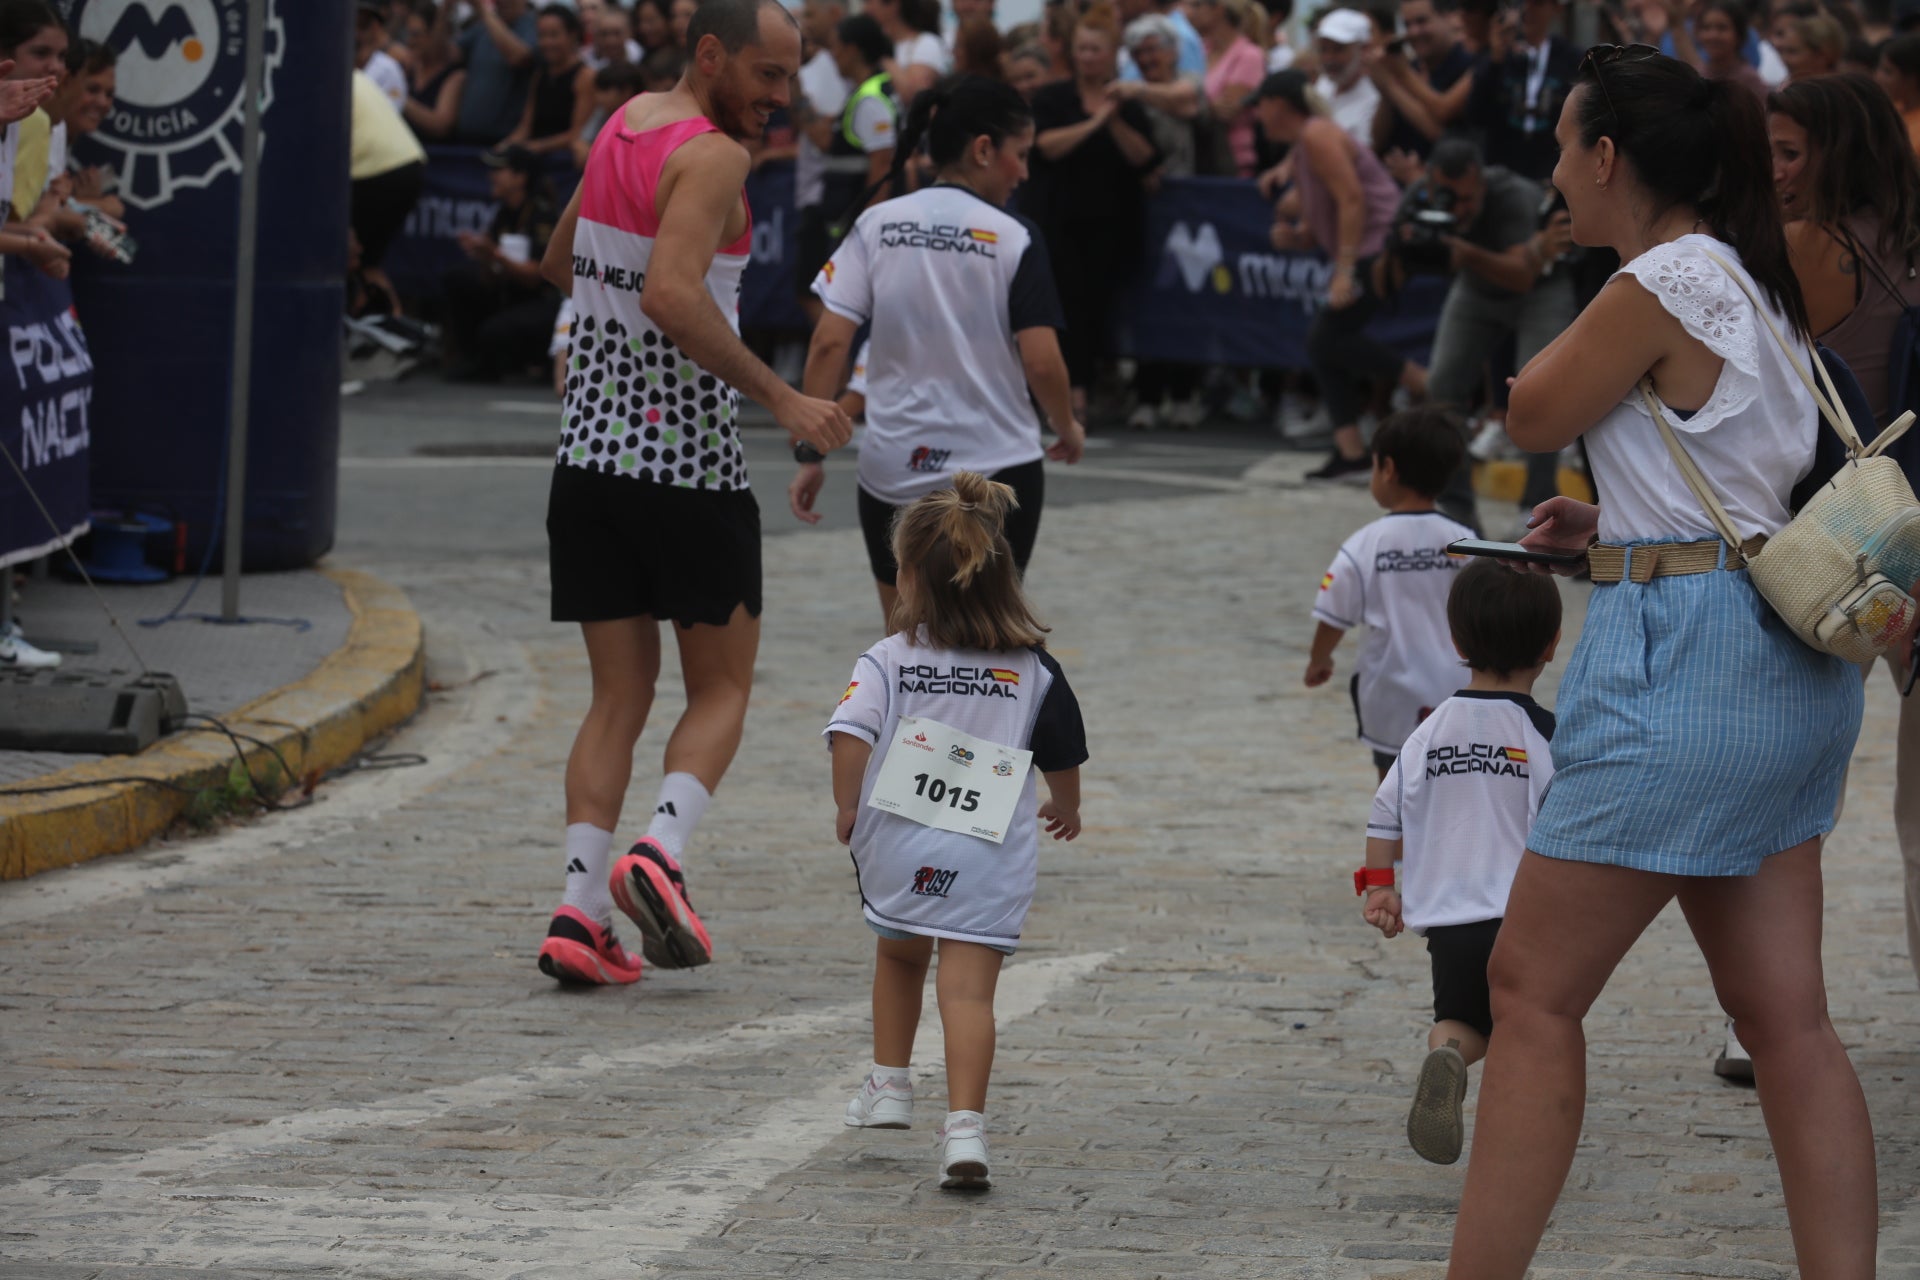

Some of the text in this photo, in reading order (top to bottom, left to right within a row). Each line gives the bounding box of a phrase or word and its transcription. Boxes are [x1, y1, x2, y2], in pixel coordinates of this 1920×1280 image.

[880, 220, 974, 241] POLICIA
[879, 234, 997, 259] NACIONAL
[1375, 547, 1448, 560] POLICIA
[899, 665, 996, 681] POLICIA
[898, 680, 1018, 700] NACIONAL
[902, 737, 936, 753] Santander
[1425, 743, 1510, 761] POLICIA
[1425, 757, 1530, 780] NACIONAL
[914, 772, 981, 812] 1015
